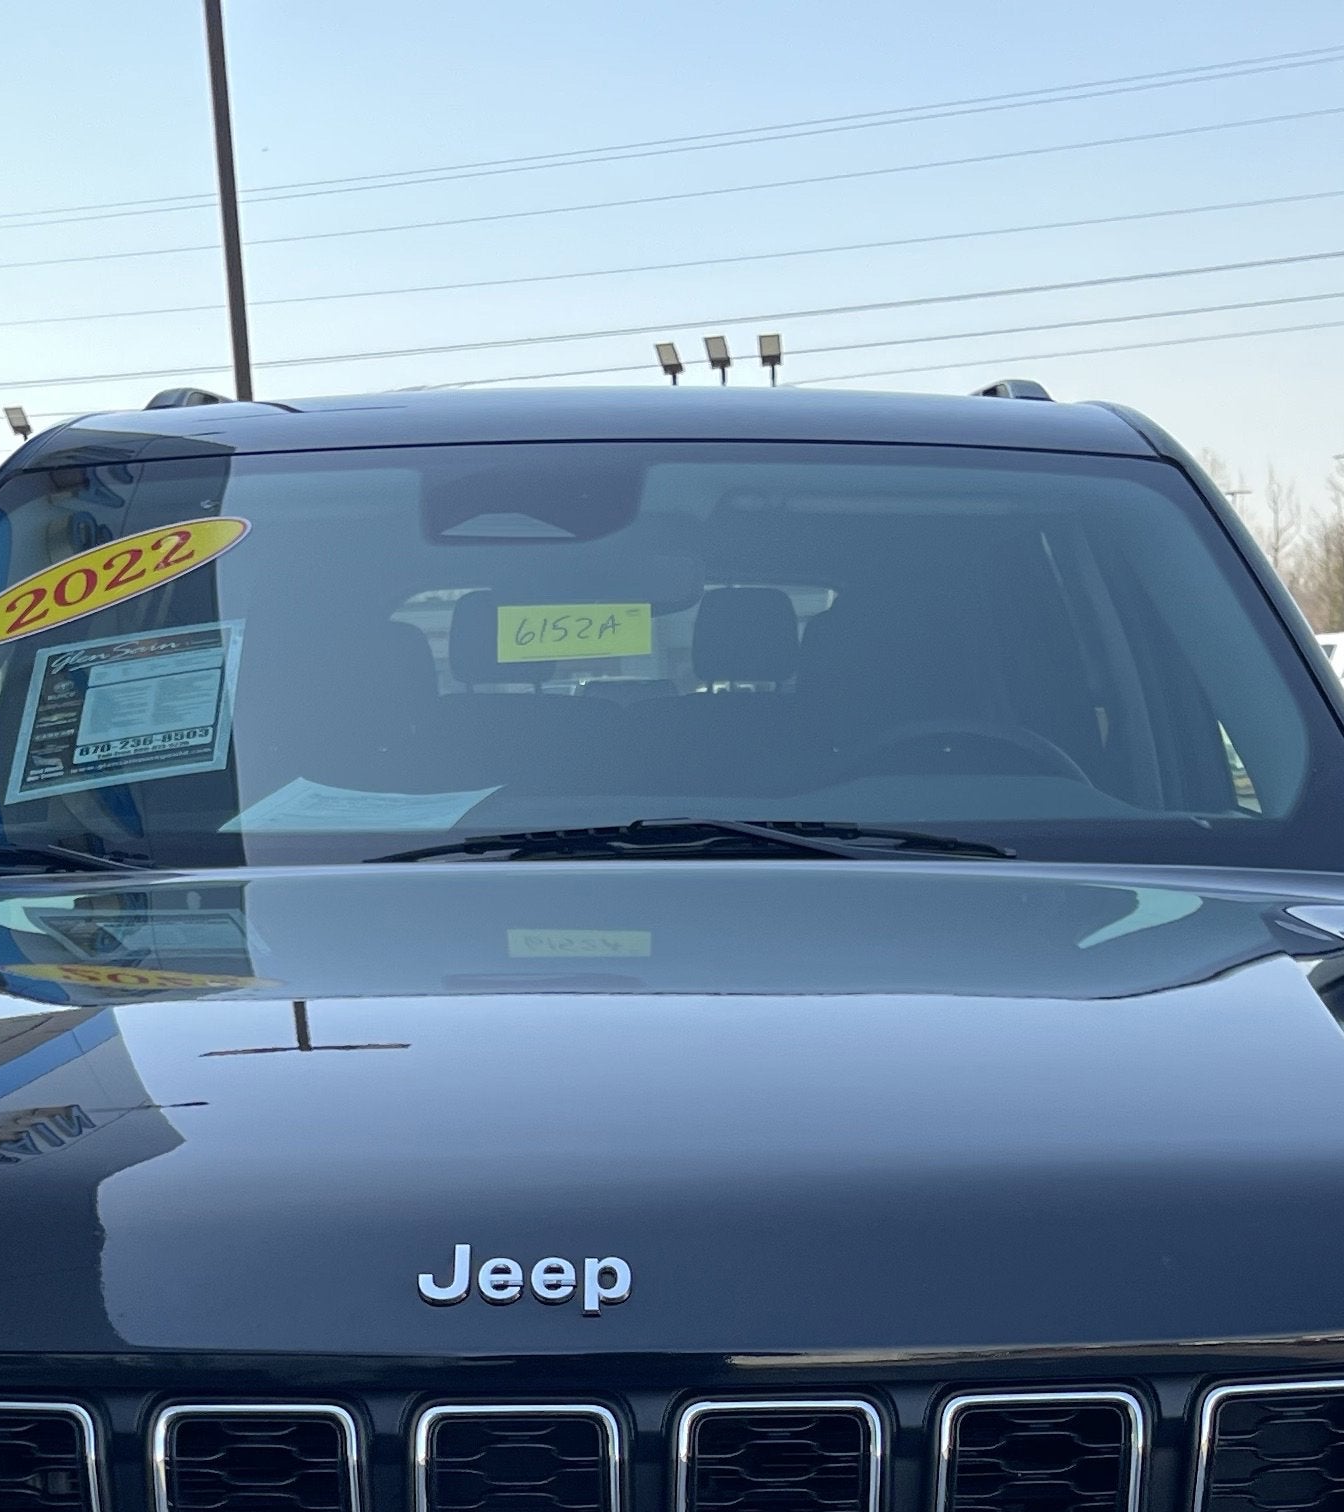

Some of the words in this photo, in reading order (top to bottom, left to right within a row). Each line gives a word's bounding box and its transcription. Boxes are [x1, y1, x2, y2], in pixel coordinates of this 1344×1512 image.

[6, 531, 195, 634] 2022
[515, 614, 622, 646] 6152A
[51, 648, 109, 674] Glen
[417, 1243, 634, 1318] Jeep
